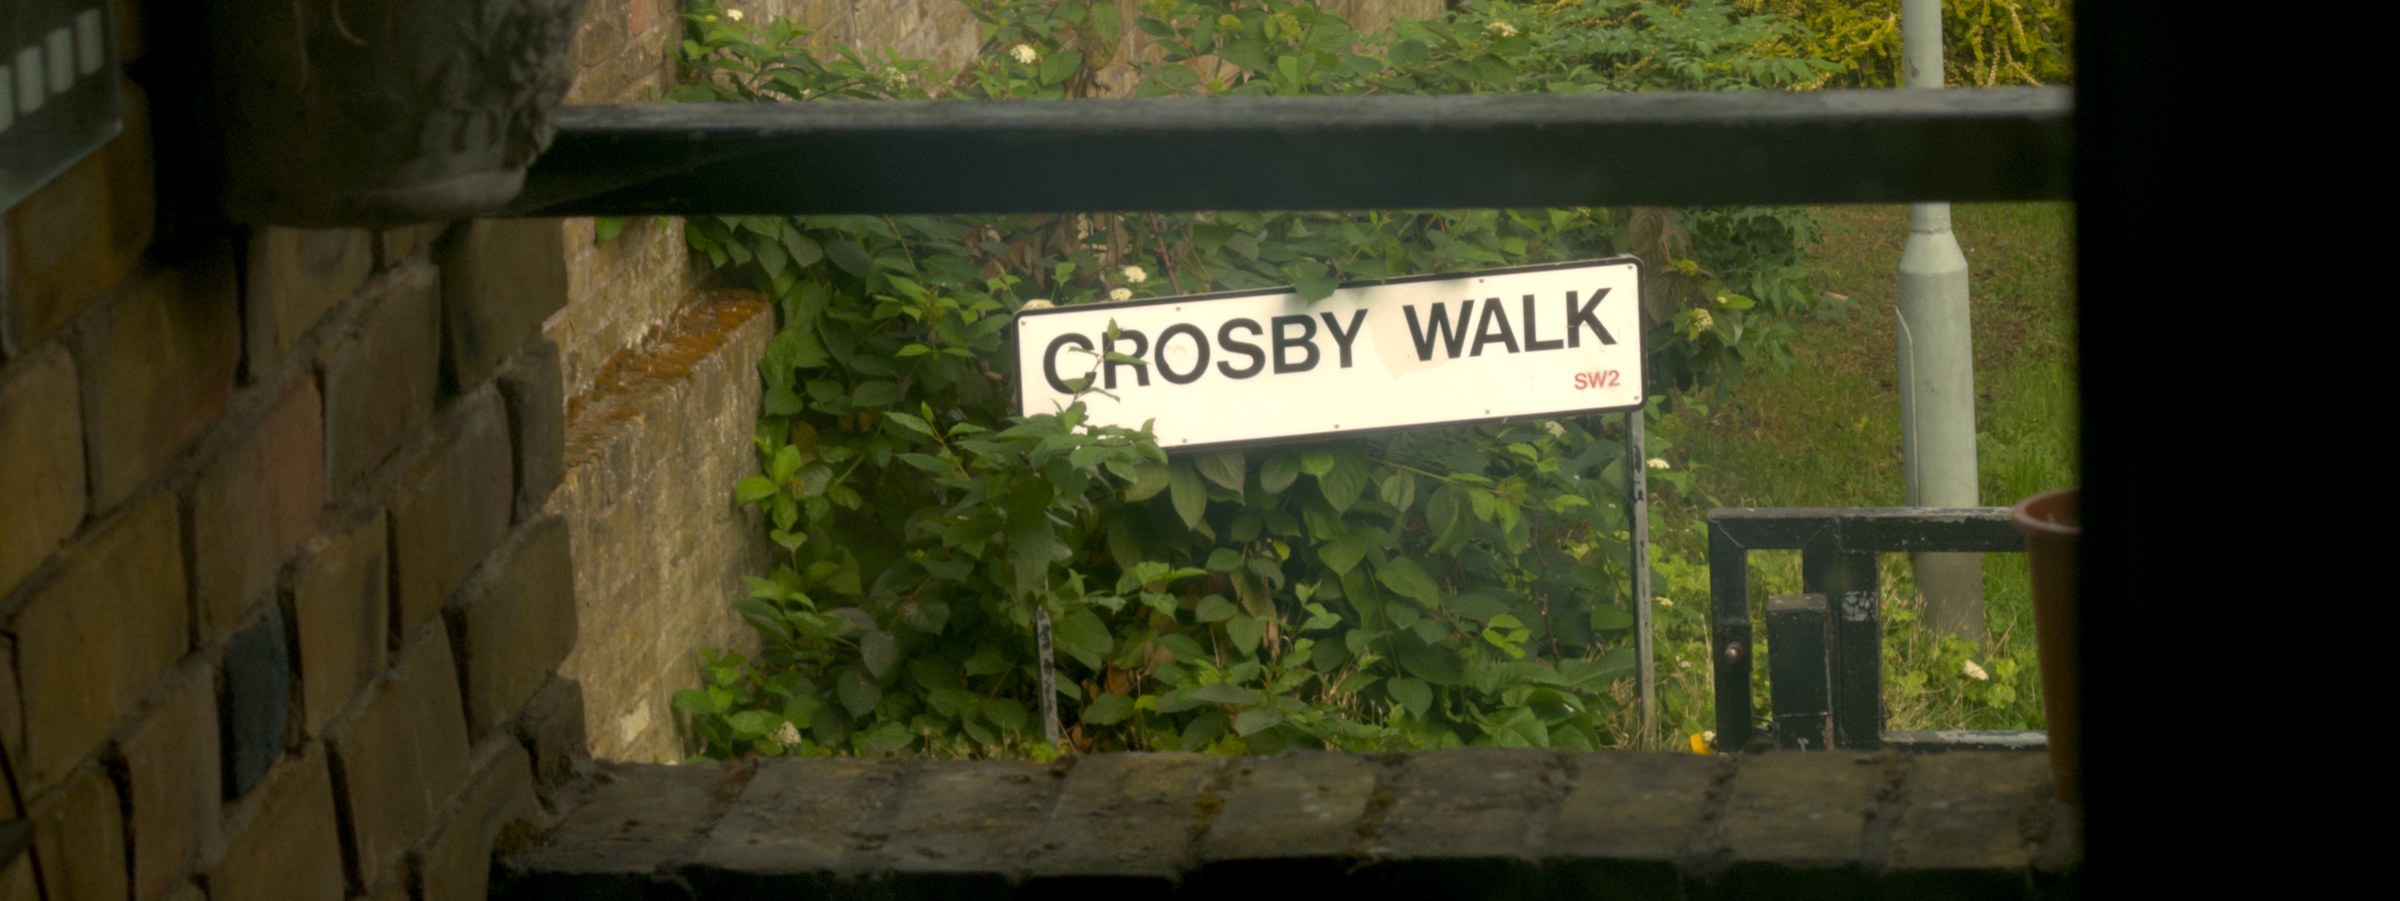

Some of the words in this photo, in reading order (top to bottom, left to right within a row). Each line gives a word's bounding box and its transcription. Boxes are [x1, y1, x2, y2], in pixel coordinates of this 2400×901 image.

[1042, 309, 1368, 395] CROSBY
[1403, 287, 1616, 361] WALK
[1574, 370, 1620, 391] SW2
